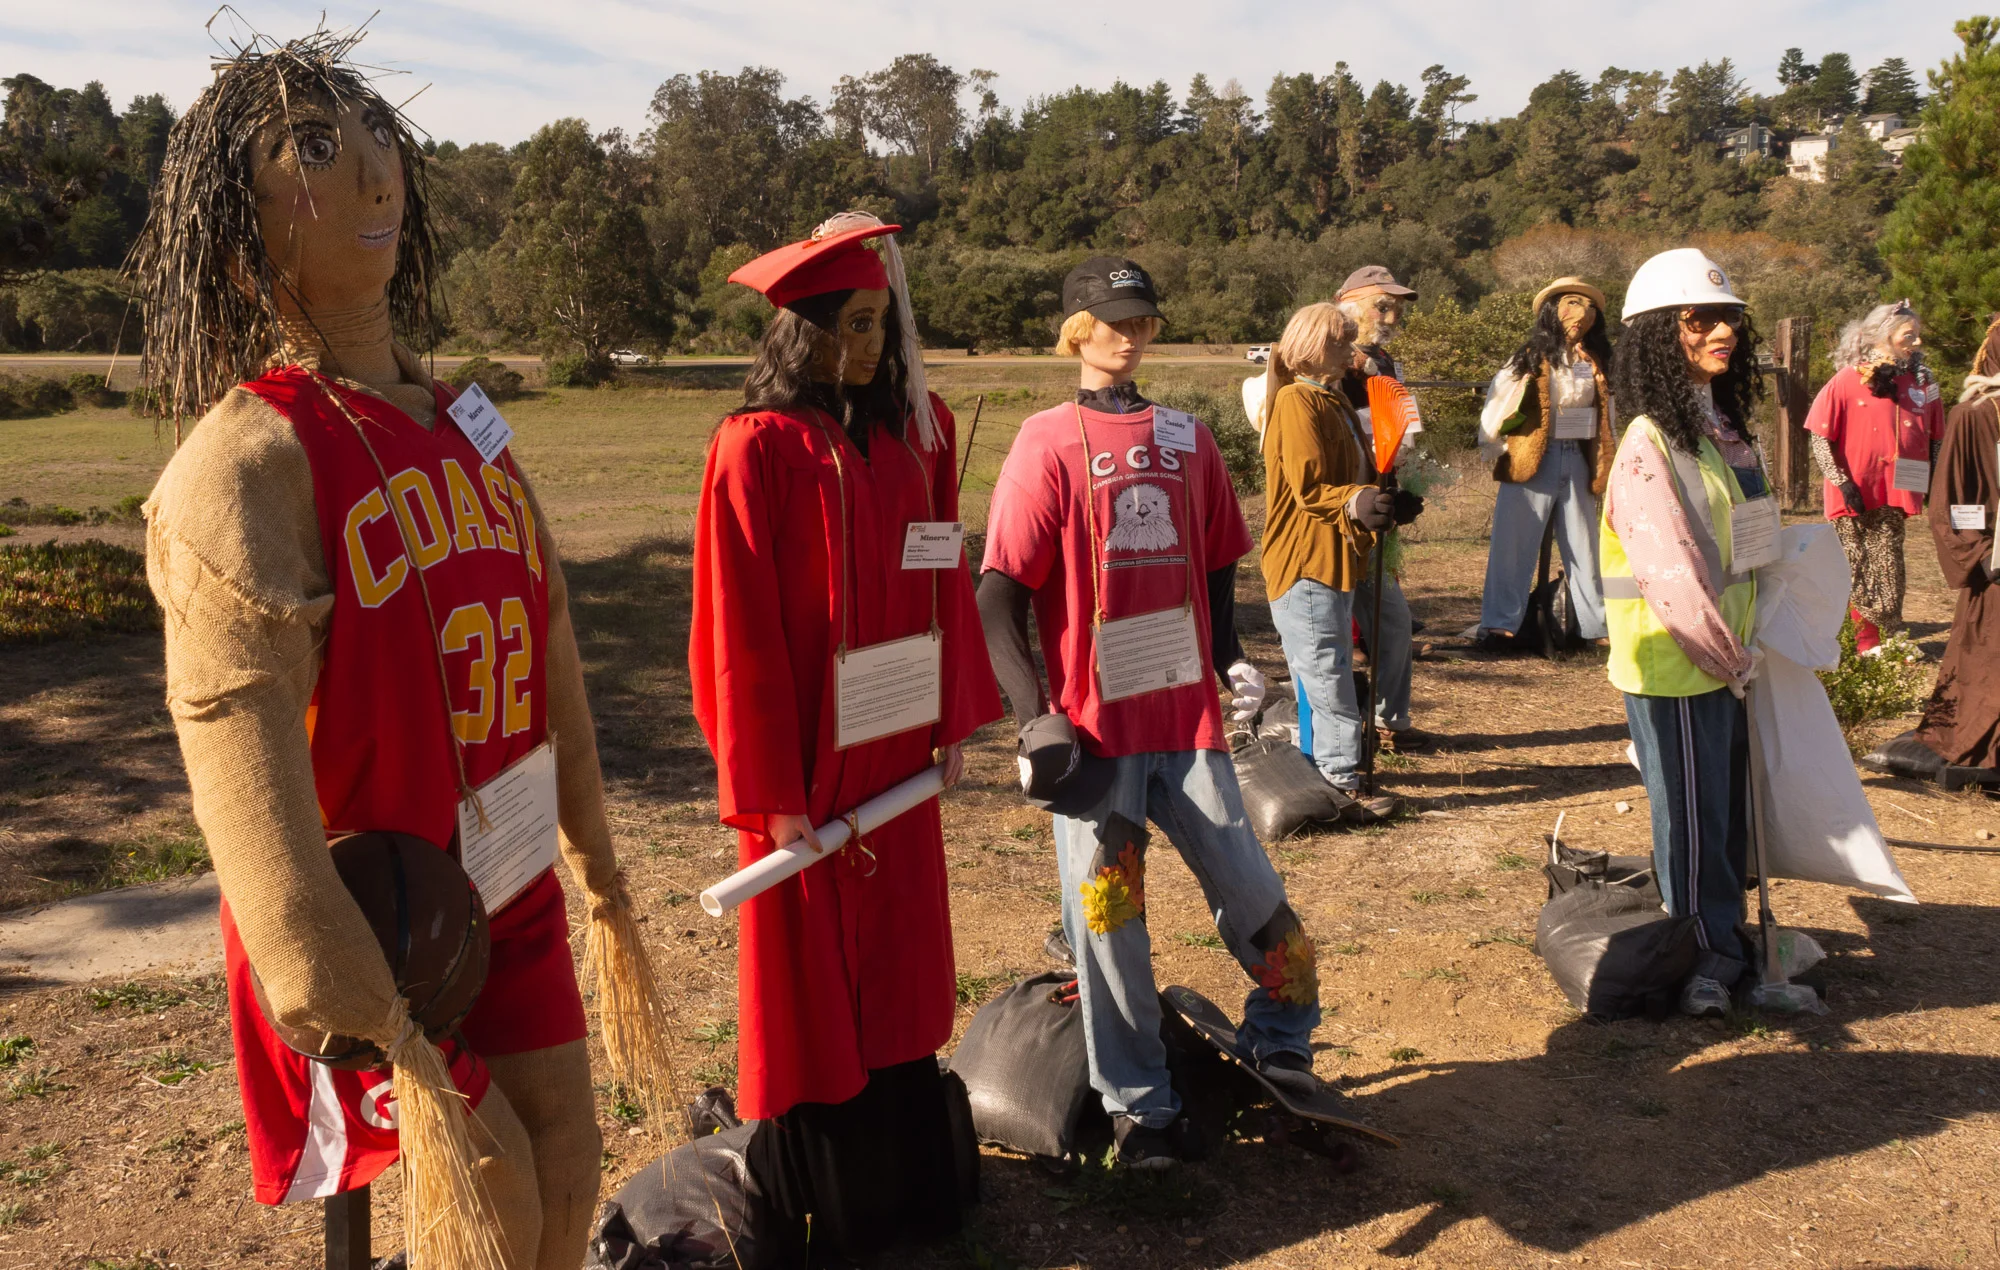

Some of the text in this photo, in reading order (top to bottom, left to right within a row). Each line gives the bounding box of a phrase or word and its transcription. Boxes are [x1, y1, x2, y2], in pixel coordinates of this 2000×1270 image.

[1110, 270, 1142, 280] COAST
[468, 404, 484, 421] Marcos
[1165, 419, 1186, 429] Cassidy
[1092, 476, 1124, 490] CAMBRIA
[1160, 472, 1183, 482] SCHOOL
[344, 459, 541, 608] COAST
[441, 597, 532, 746] 32
